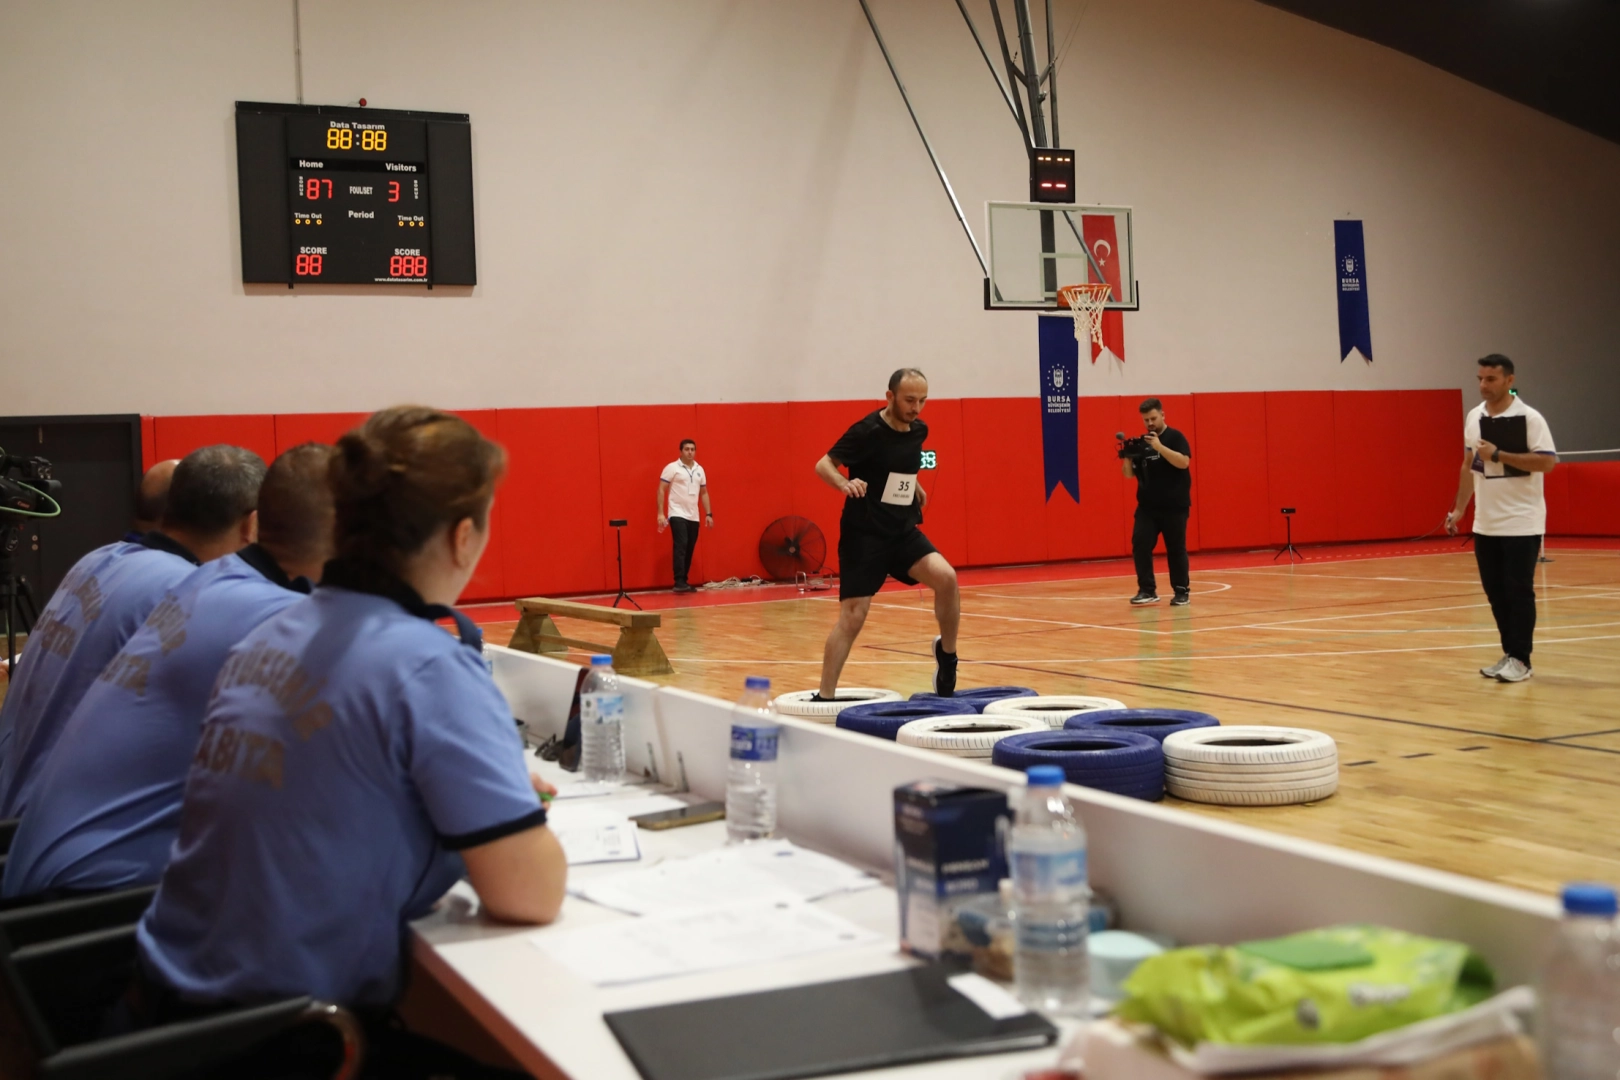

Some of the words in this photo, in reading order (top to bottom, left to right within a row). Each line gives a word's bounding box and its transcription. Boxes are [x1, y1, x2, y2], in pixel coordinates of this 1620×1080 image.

[330, 121, 350, 129] Data
[299, 160, 324, 168] Home
[386, 163, 416, 172] Visitors
[306, 178, 332, 200] 87
[388, 181, 400, 202] 3
[348, 210, 374, 218] Period
[296, 254, 322, 276] 88
[390, 256, 427, 276] 888
[898, 480, 910, 492] 35
